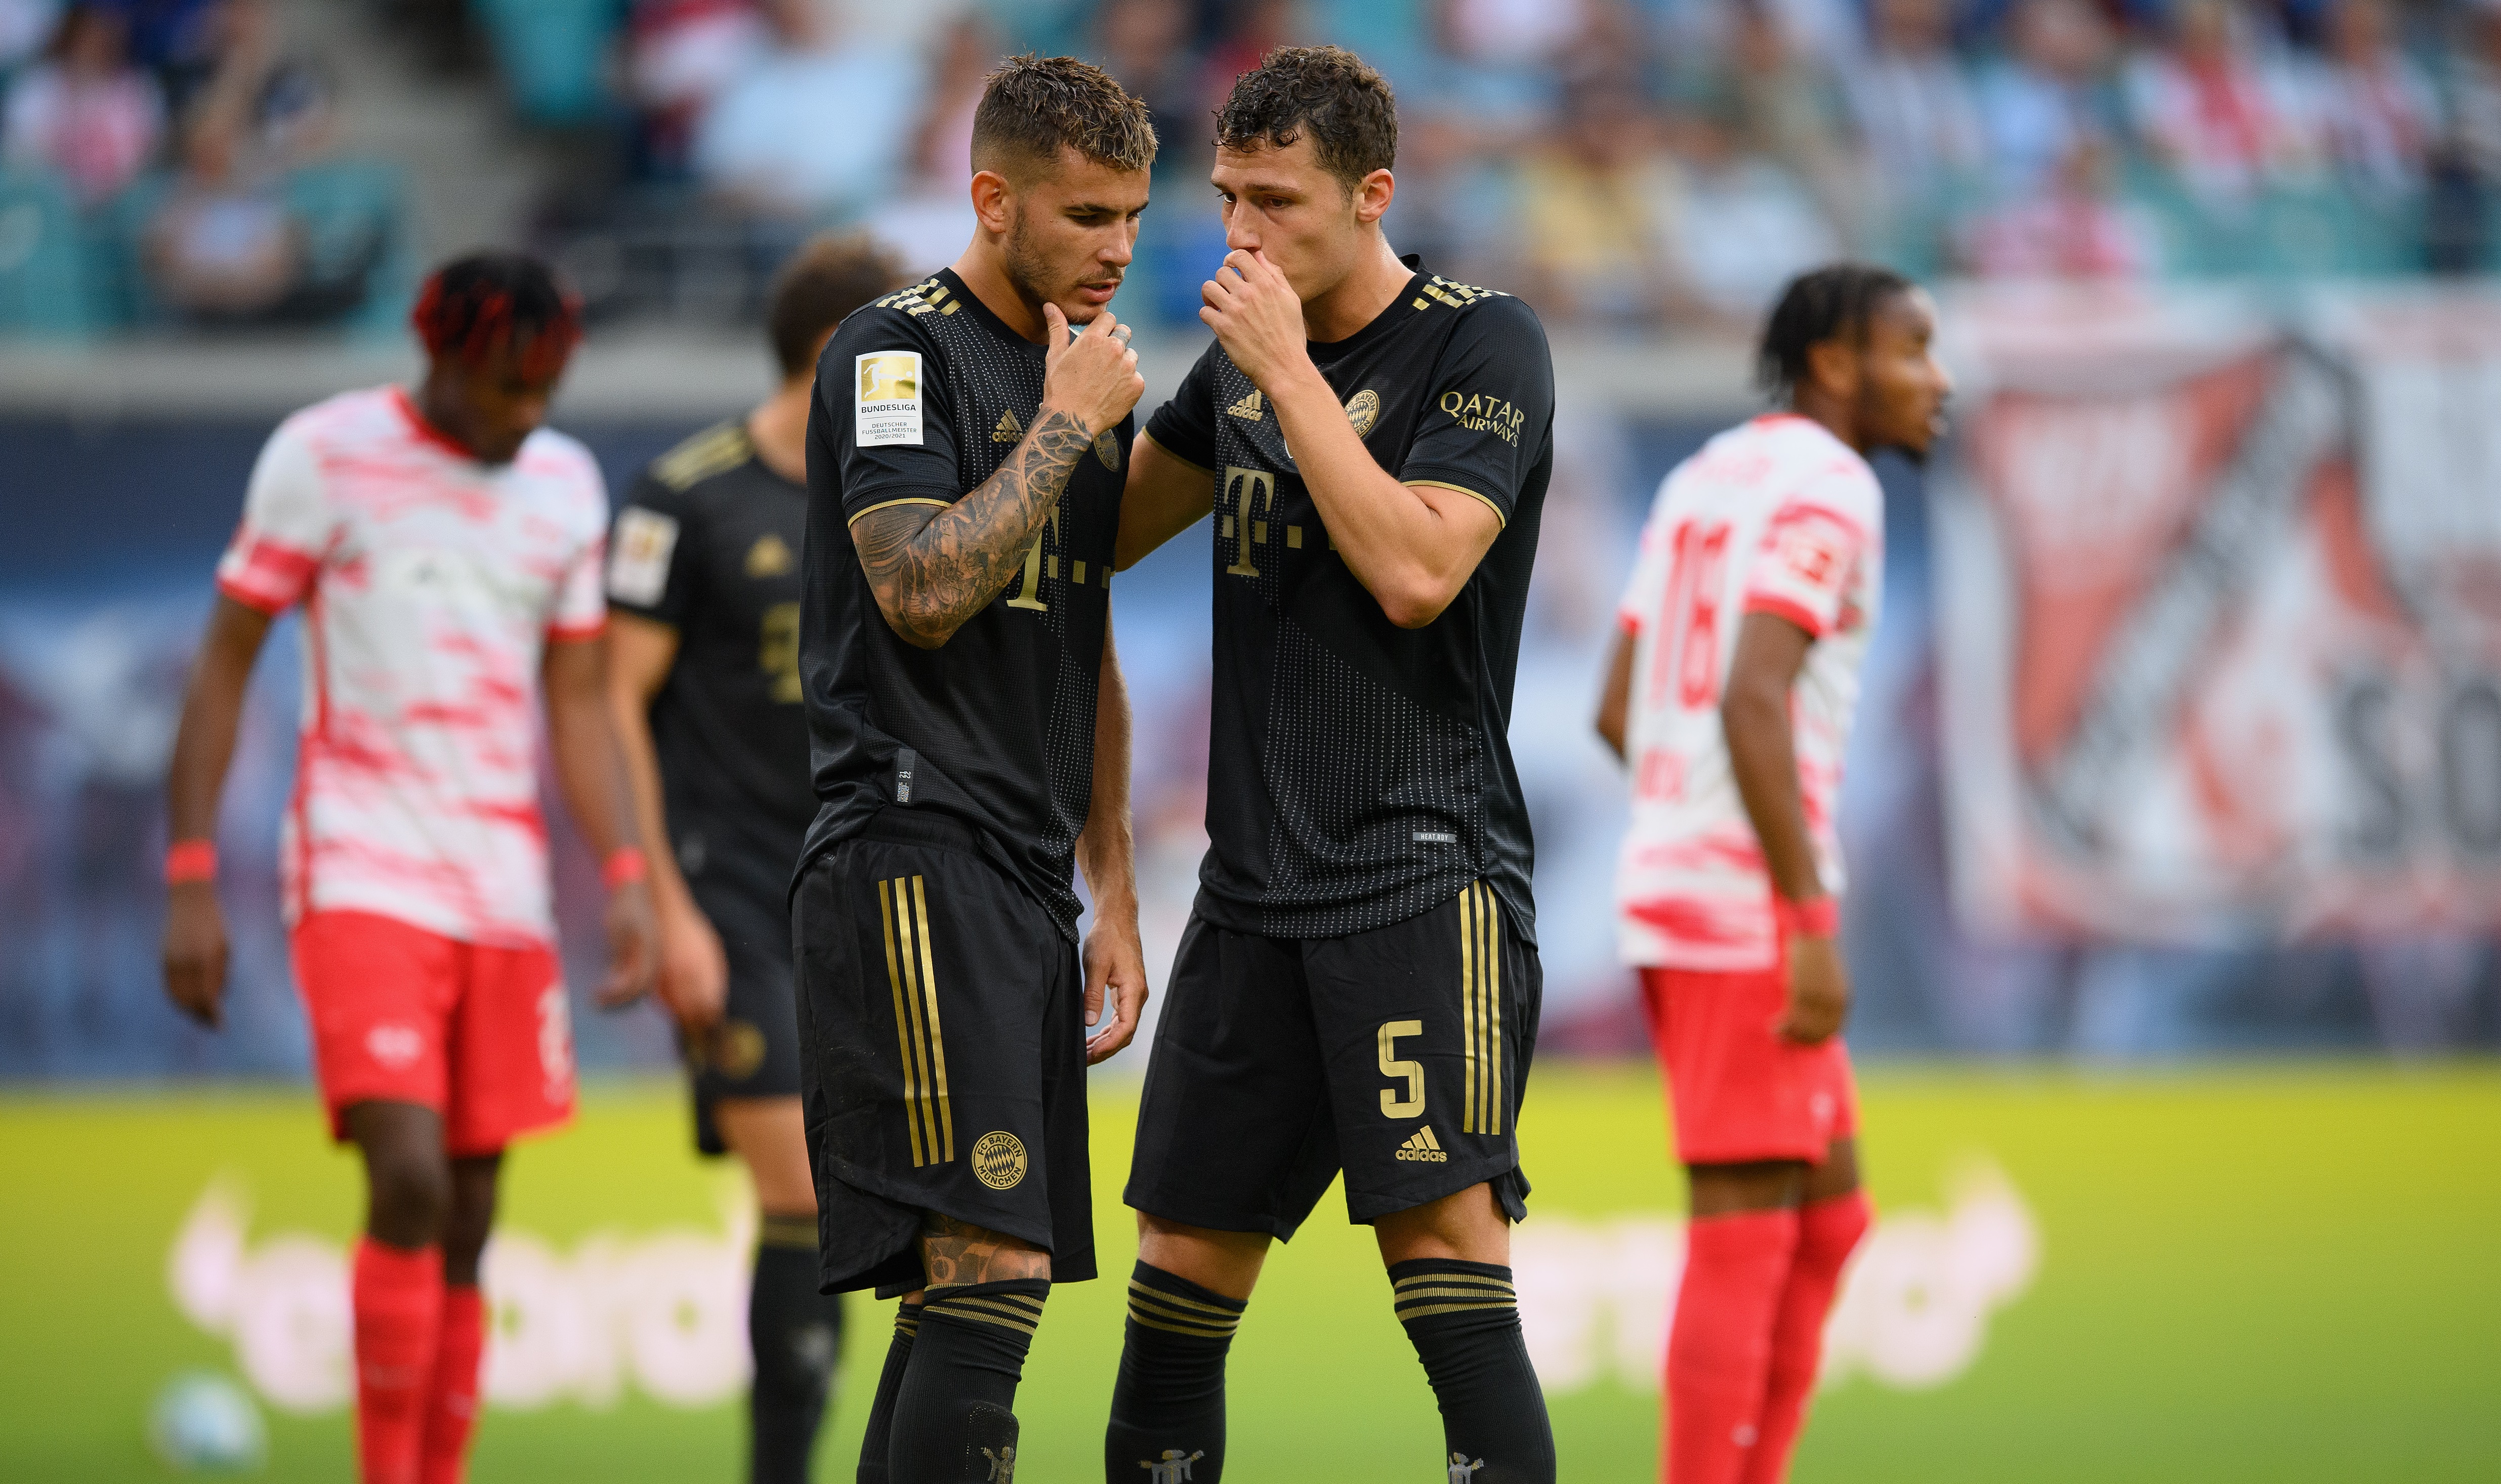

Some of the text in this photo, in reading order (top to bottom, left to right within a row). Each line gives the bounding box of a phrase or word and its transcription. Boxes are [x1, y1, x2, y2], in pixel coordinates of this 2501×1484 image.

[861, 404, 916, 413] BUNDESLIGA
[1356, 393, 1375, 411] BAYERN
[1227, 405, 1263, 421] adidas
[1440, 391, 1524, 435] QATAR
[992, 429, 1023, 443] adida
[1456, 414, 1518, 447] AIRWAYS
[1378, 1020, 1426, 1119] 5
[977, 1135, 1022, 1157] FC BAYERN
[1395, 1147, 1447, 1162] adidas
[977, 1165, 1022, 1185] MÜNCHEN
